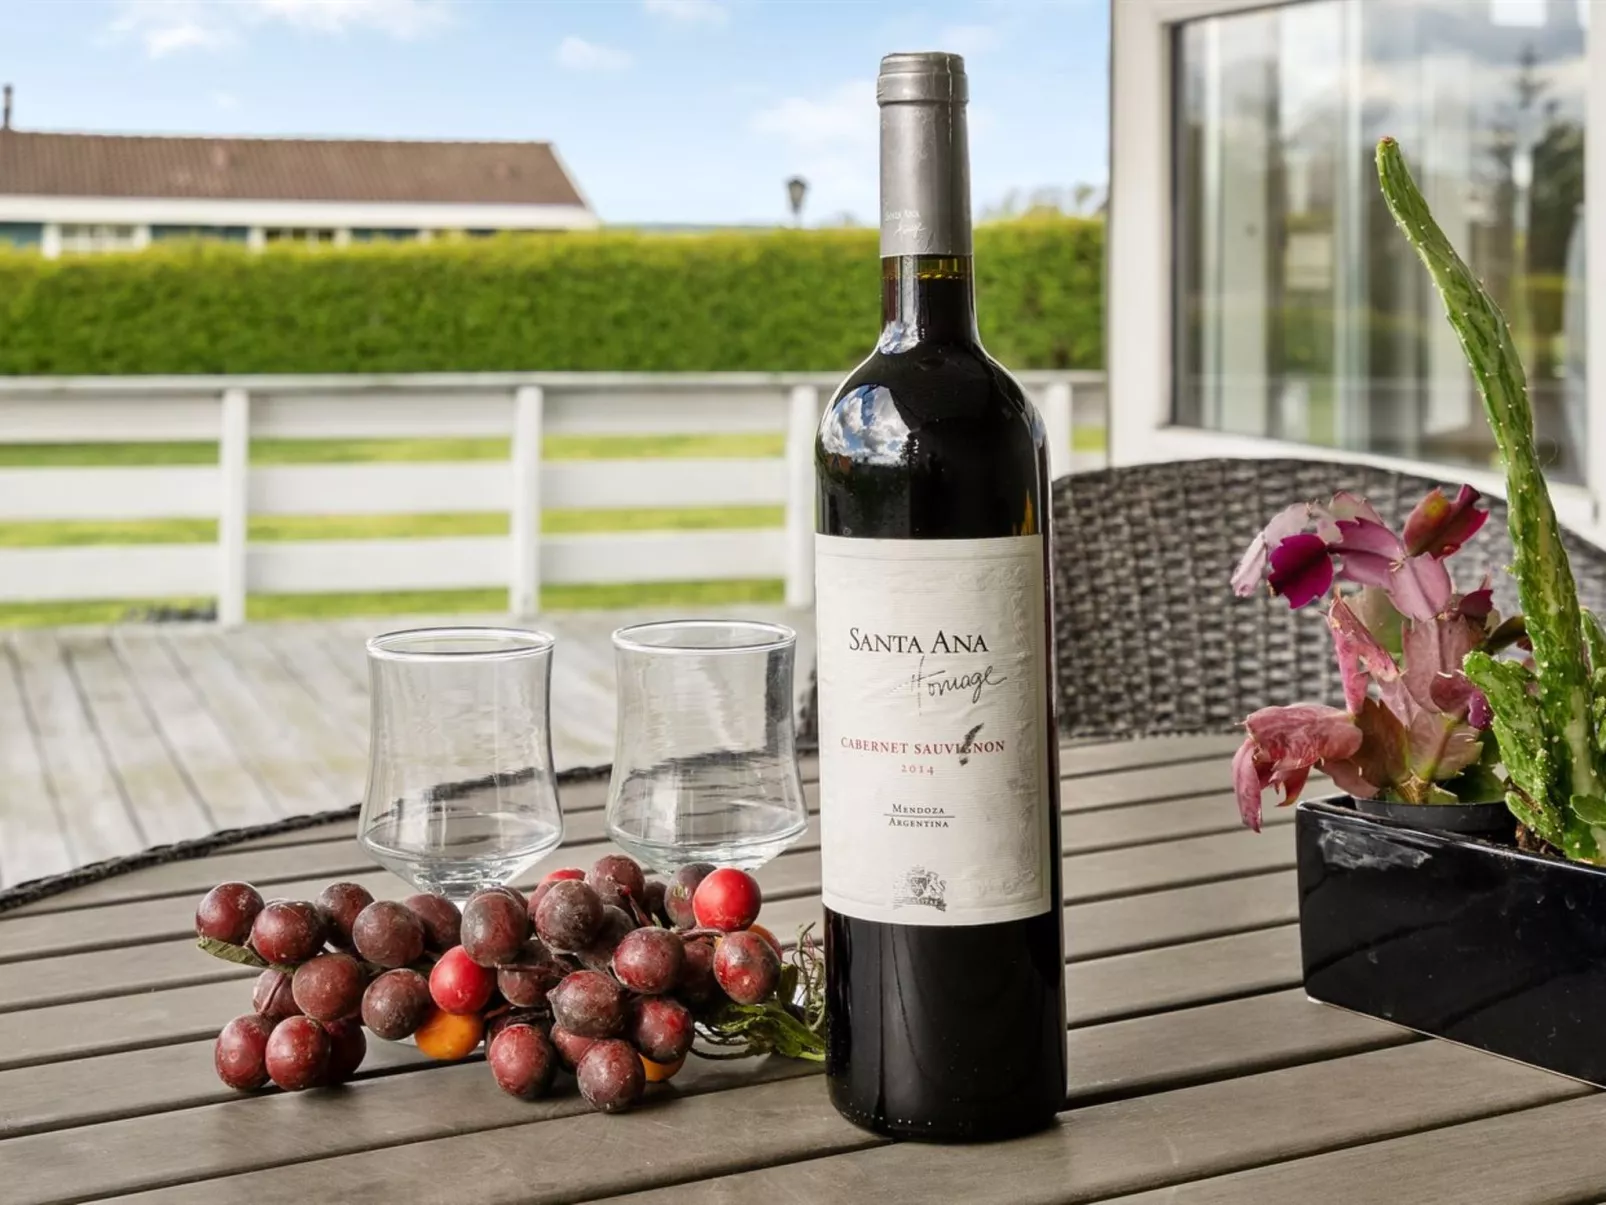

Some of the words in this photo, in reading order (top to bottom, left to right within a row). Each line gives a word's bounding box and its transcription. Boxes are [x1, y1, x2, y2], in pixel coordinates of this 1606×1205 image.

[849, 627, 924, 654] SANTA
[930, 629, 989, 654] ANA
[841, 737, 908, 754] CABERNET
[914, 740, 1005, 755] SAUVIGNON
[901, 764, 934, 776] 2014
[892, 803, 945, 815] MENDOZA
[888, 817, 949, 828] ARGENTINA
